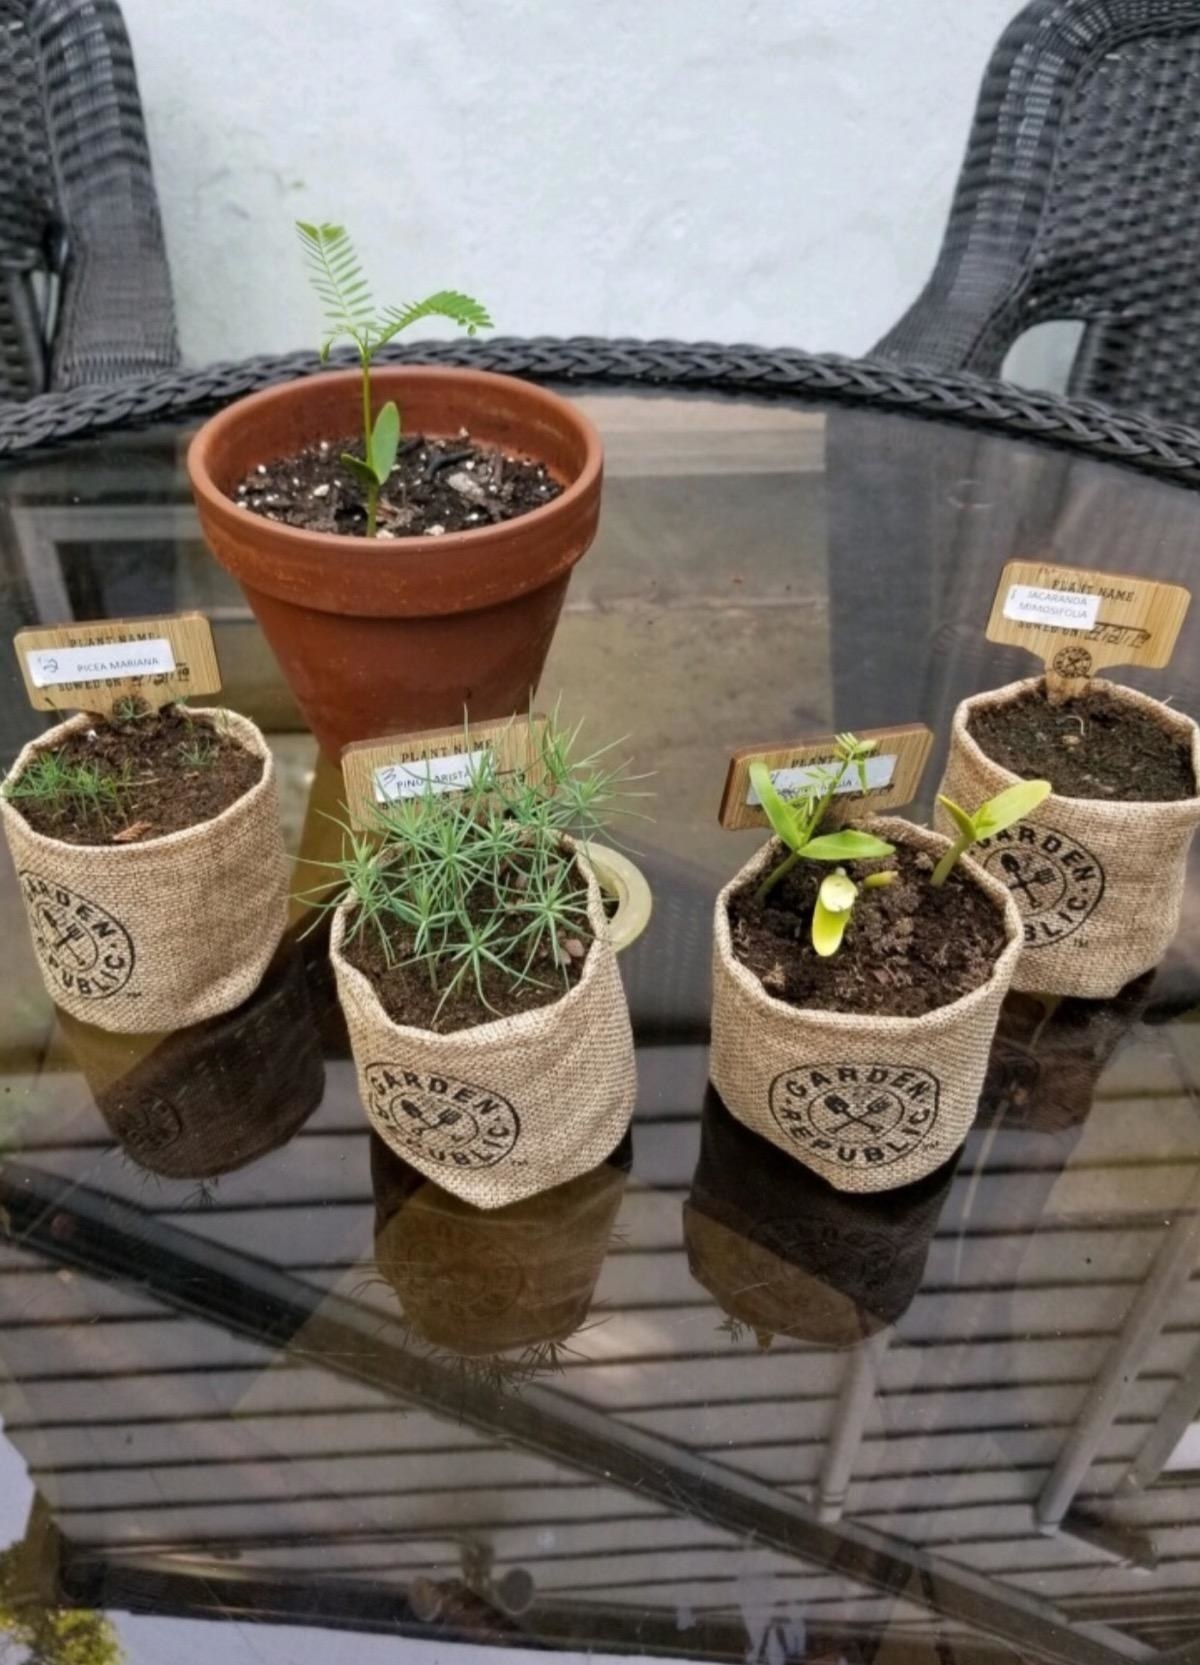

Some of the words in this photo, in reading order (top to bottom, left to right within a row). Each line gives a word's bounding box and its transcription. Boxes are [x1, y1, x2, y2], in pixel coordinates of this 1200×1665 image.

[1052, 579, 1094, 594] PLANT
[1028, 591, 1087, 606] JACARANDA
[1019, 602, 1087, 618] MIMOSIFOLIA
[77, 663, 107, 674] PICEA
[109, 657, 160, 670] MARIANA
[402, 746, 447, 763] PLANT
[397, 776, 430, 791] PINU
[433, 767, 476, 784] ARISTA
[1023, 897, 1088, 942] BLIC
[371, 1070, 499, 1115] GARDEN
[786, 1068, 930, 1099] GARDEN
[780, 1107, 931, 1162] REPUBLIC
